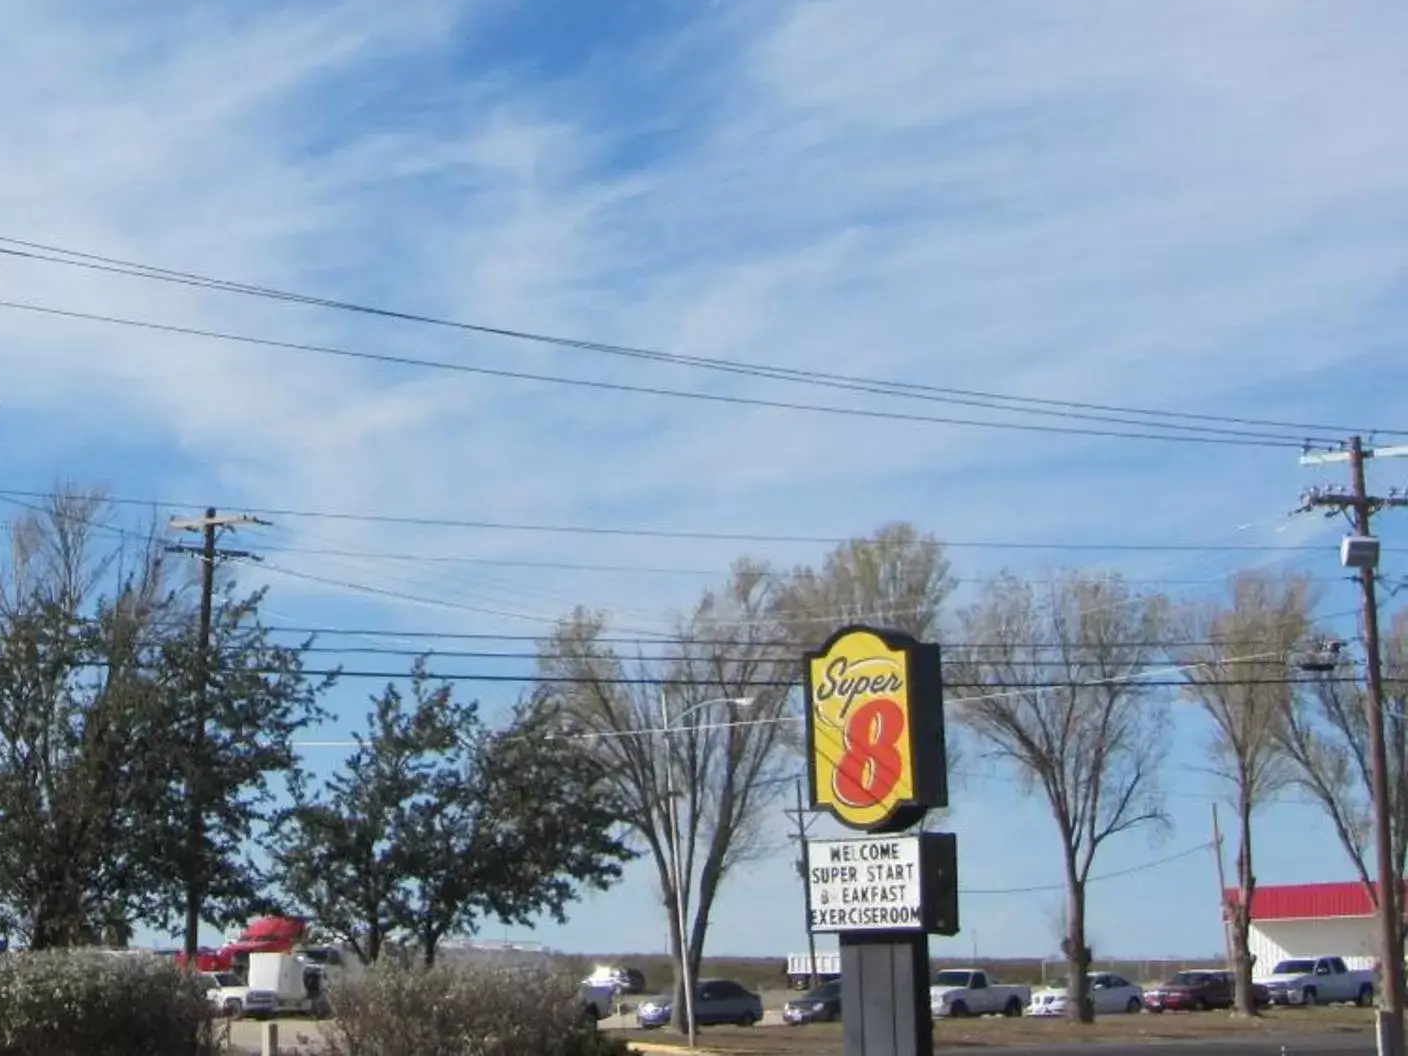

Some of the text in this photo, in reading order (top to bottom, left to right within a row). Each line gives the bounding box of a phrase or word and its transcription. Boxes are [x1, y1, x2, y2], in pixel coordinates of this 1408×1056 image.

[816, 656, 904, 718] Super
[831, 698, 905, 808] 8
[830, 843, 900, 862] WELCOME
[812, 863, 914, 884] SUPER START
[820, 884, 906, 905] BEAKFAST
